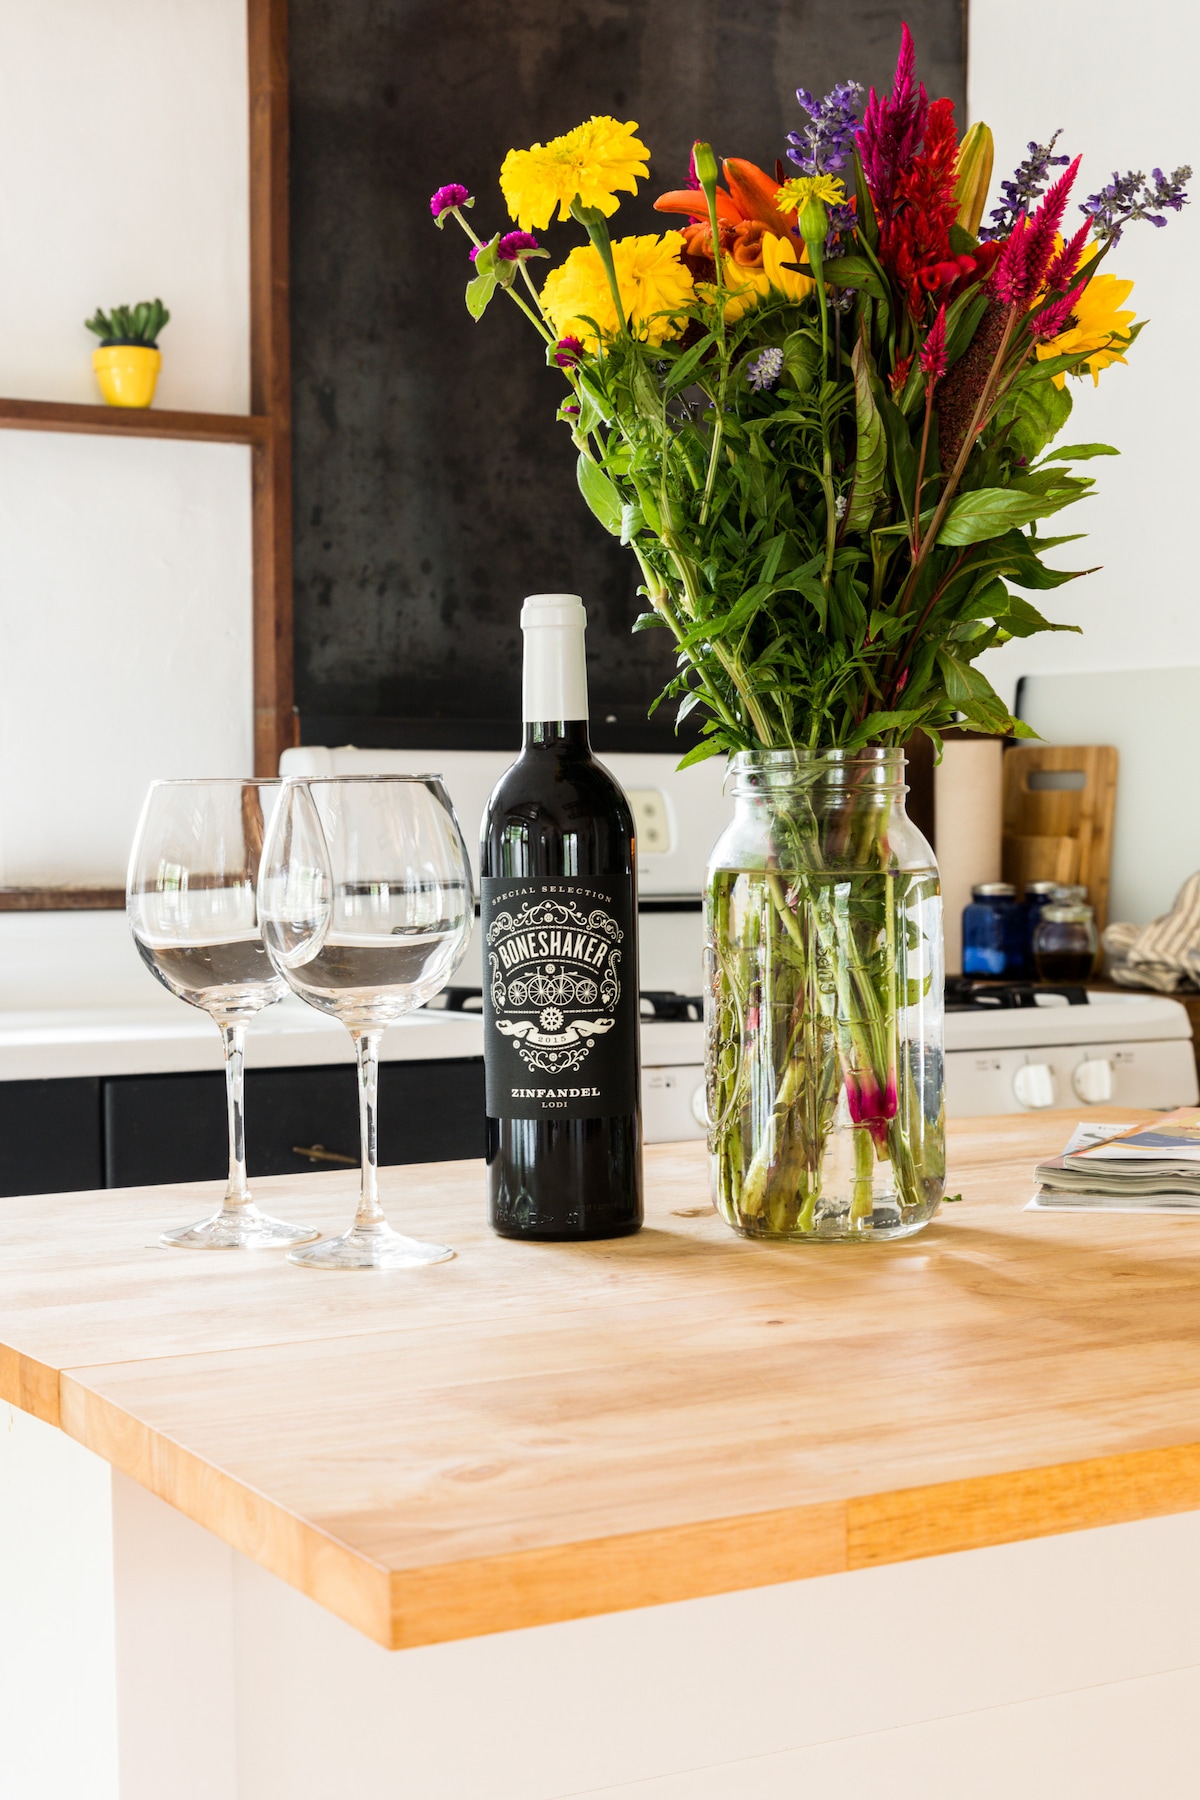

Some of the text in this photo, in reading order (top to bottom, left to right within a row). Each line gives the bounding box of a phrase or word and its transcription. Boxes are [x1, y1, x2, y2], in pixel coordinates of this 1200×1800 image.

[492, 885, 612, 906] SPECIAL SELECTION
[498, 930, 608, 970] BONESHAKER
[537, 1035, 567, 1044] 2015
[511, 1087, 601, 1098] ZINFANDEL
[541, 1101, 568, 1109] LODI
[822, 1120, 834, 1134] 2
